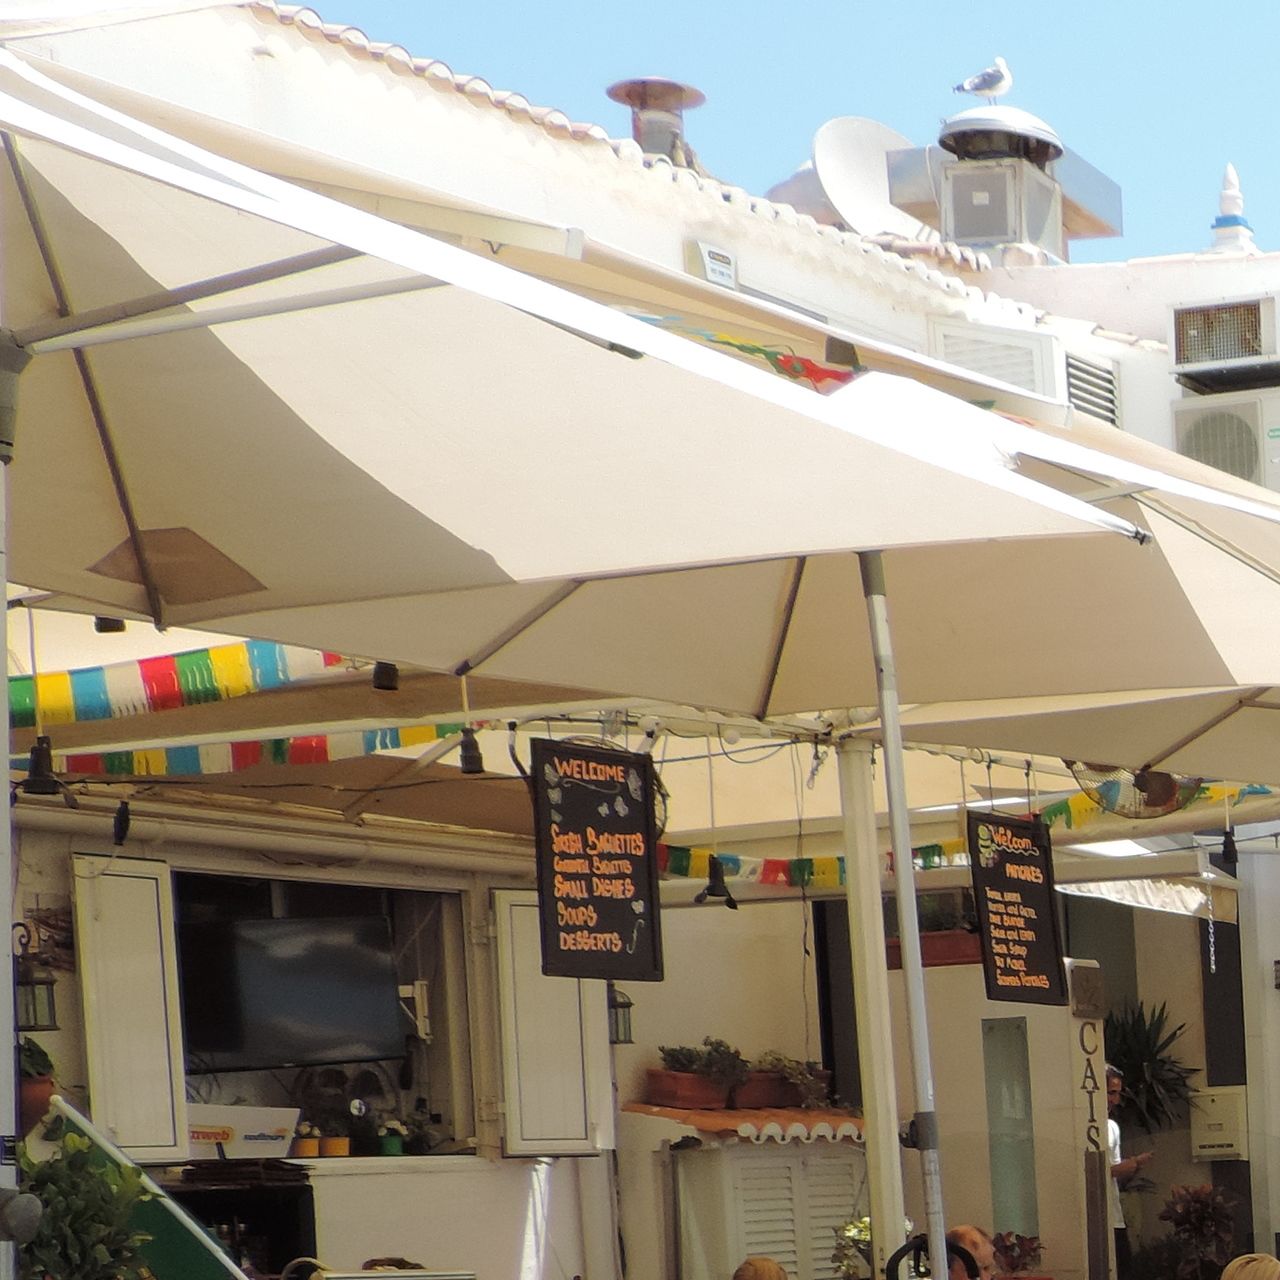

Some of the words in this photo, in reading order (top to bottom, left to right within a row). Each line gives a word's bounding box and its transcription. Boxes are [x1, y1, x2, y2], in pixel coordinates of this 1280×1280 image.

[554, 757, 625, 782] WELCOME
[592, 877, 635, 898] DISHES
[557, 901, 597, 927] SOUPS
[560, 930, 622, 953] DESSERTS
[1079, 1021, 1100, 1150] CAIS
